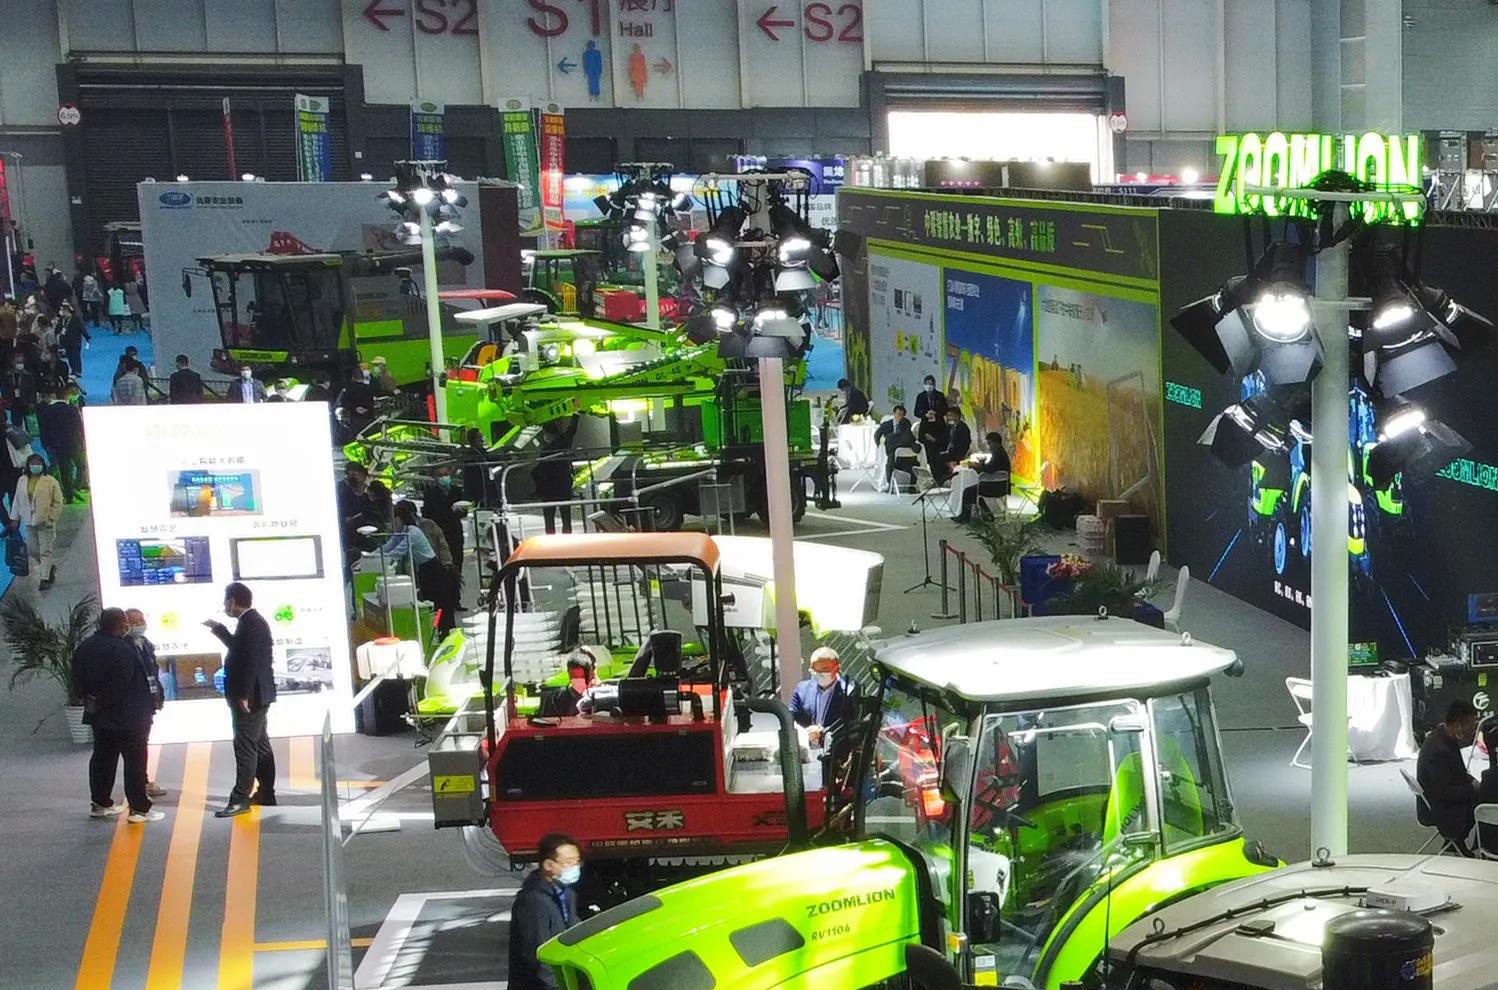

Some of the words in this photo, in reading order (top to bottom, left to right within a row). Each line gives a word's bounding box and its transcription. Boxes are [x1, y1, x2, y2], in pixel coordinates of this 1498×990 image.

[415, 0, 479, 35] S2
[527, 0, 601, 37] S1
[620, 21, 653, 37] Hall
[804, 3, 864, 42] S2
[1214, 131, 1425, 227] ZOOMLION
[624, 809, 684, 832] 艾禾
[806, 889, 897, 919] ZOOMLION
